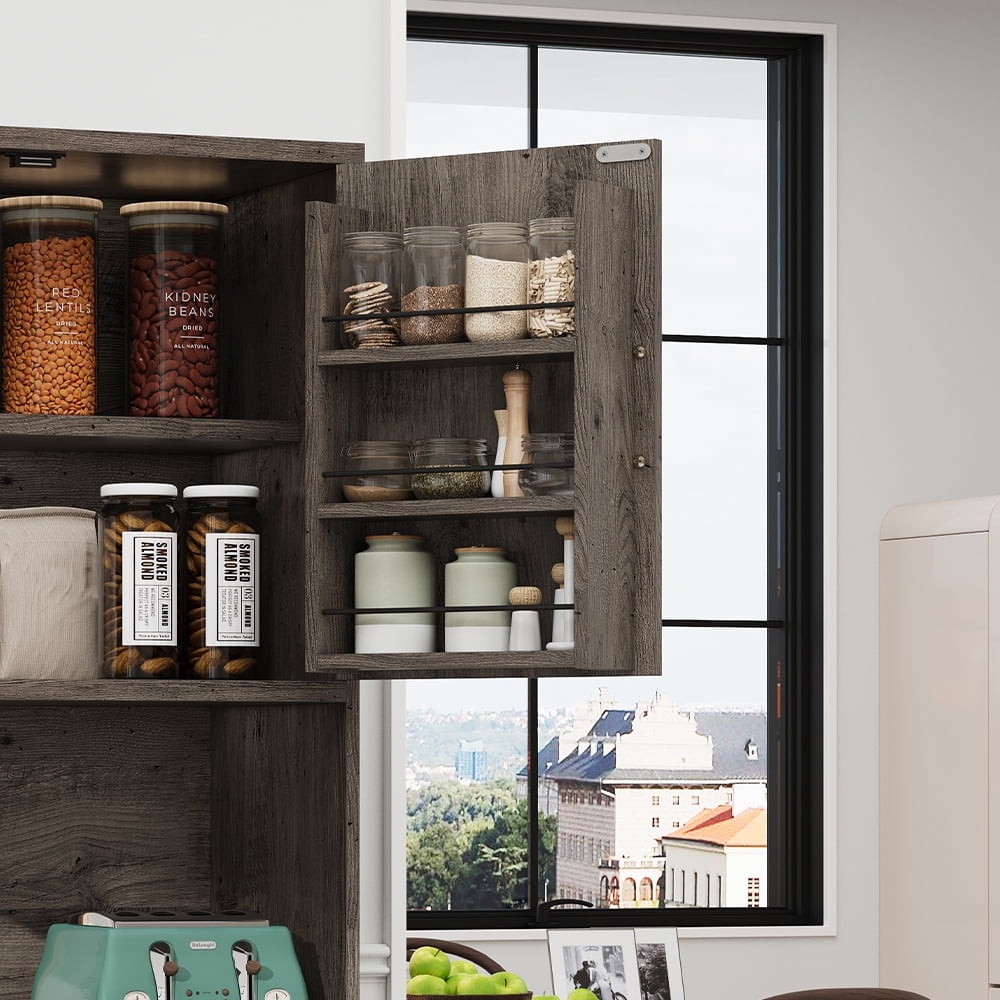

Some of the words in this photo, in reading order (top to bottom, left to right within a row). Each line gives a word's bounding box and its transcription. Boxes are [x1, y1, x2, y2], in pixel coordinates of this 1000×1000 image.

[52, 288, 80, 298] RED
[165, 292, 216, 303] KIDNEY
[36, 301, 91, 314] LENTILS
[169, 306, 214, 318] BEANS
[141, 542, 155, 581] ALMOND
[156, 542, 168, 582] SMOKED
[224, 543, 238, 582] ALMOND
[239, 543, 250, 582] SMOKED
[160, 587, 170, 599] 03
[244, 588, 253, 600] 03
[161, 604, 169, 627] ALMOND
[244, 605, 252, 628] ALMOND
